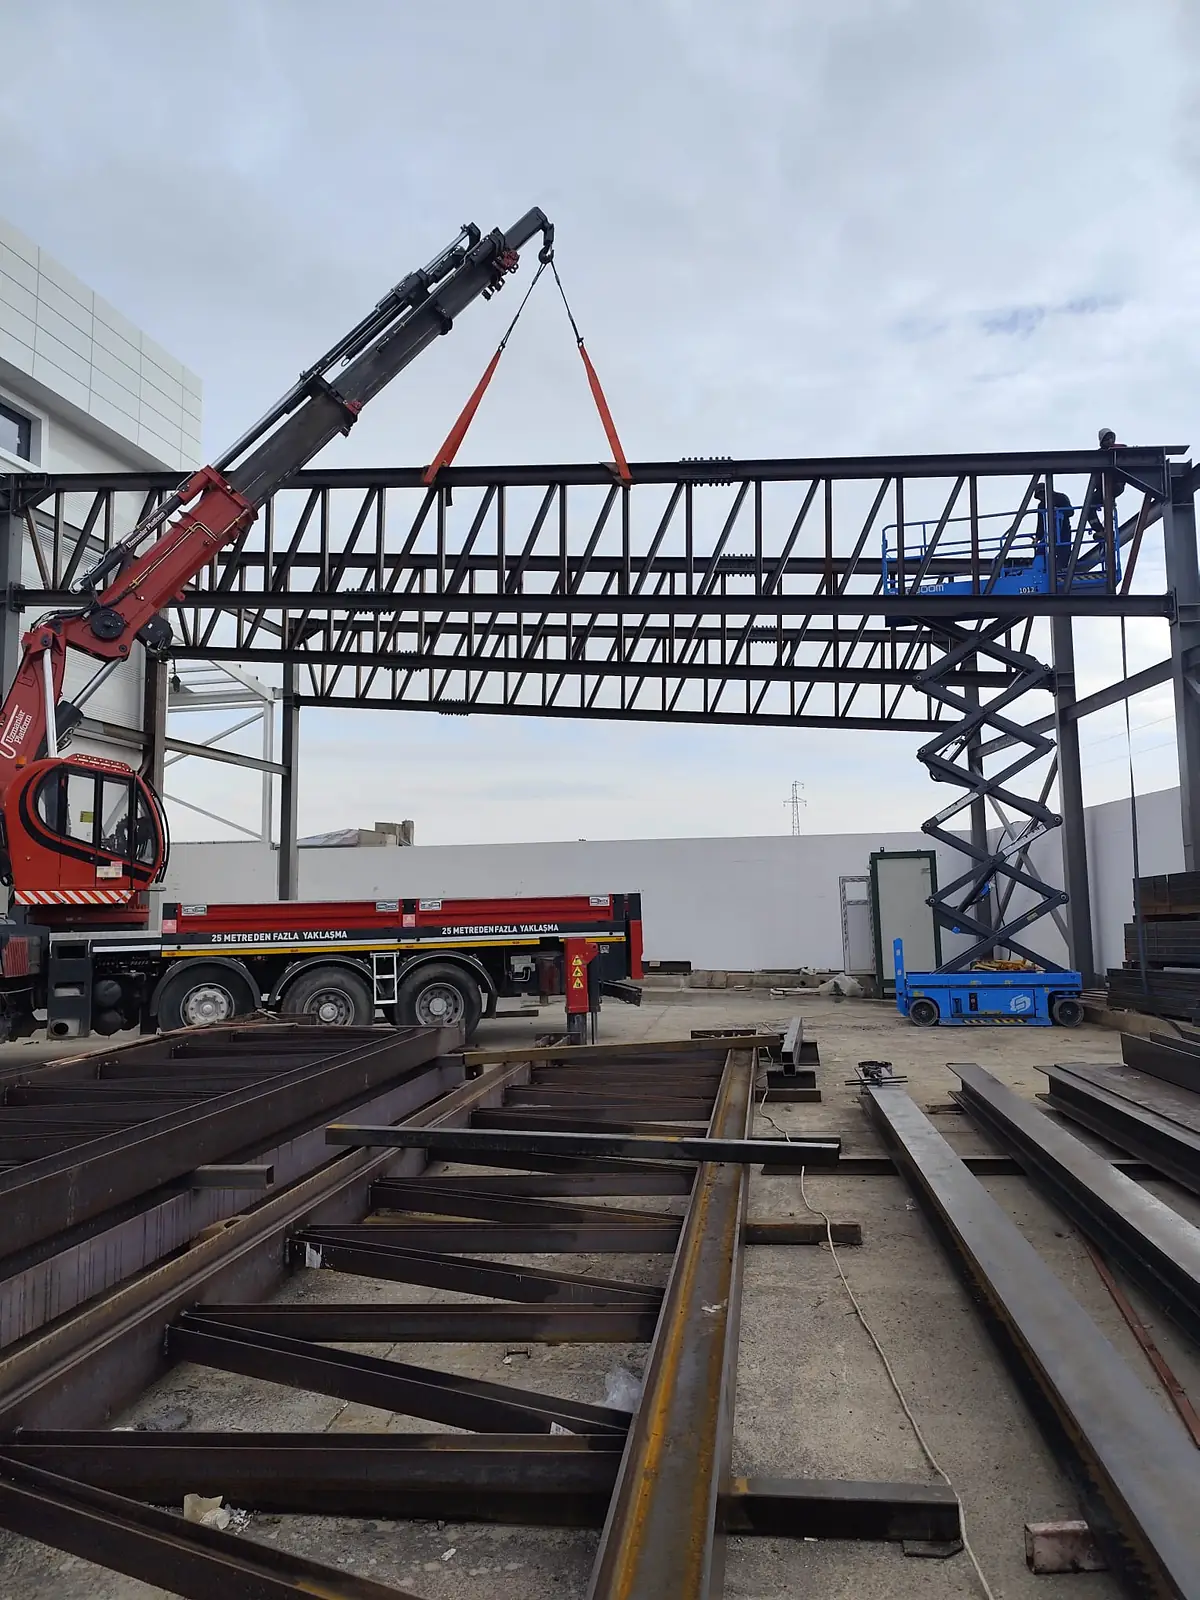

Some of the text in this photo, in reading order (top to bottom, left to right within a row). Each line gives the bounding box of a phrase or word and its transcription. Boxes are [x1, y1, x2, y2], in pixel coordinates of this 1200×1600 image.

[146, 511, 165, 530] Platform
[5, 709, 26, 744] Uzmanlar
[14, 714, 33, 745] Platform
[211, 930, 348, 943] 25 METREDEN FAZLA YAKLAŞMA
[441, 924, 559, 935] 25 METREDEN FAZLA YAKLAŞMA
